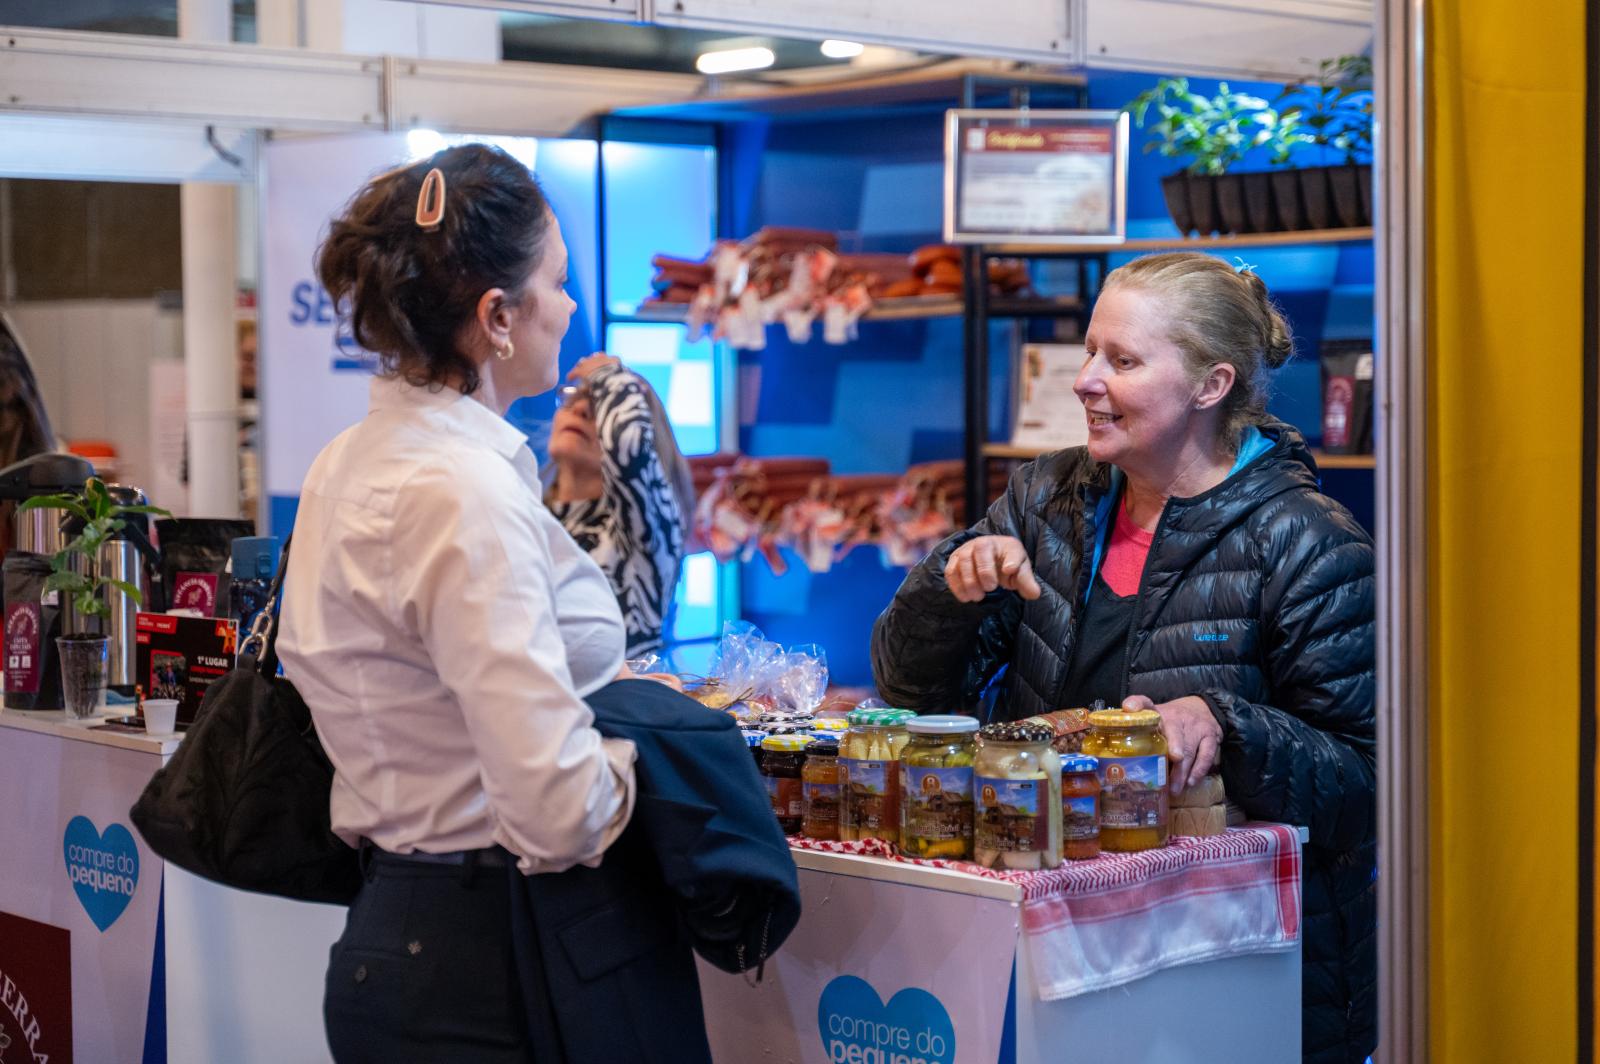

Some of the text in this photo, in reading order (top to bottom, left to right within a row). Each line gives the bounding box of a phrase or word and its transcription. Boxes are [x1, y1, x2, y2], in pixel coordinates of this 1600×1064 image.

[205, 656, 229, 668] LUGAR
[69, 844, 134, 875] compre do
[69, 864, 134, 897] pequeno
[828, 1013, 946, 1057] compre do
